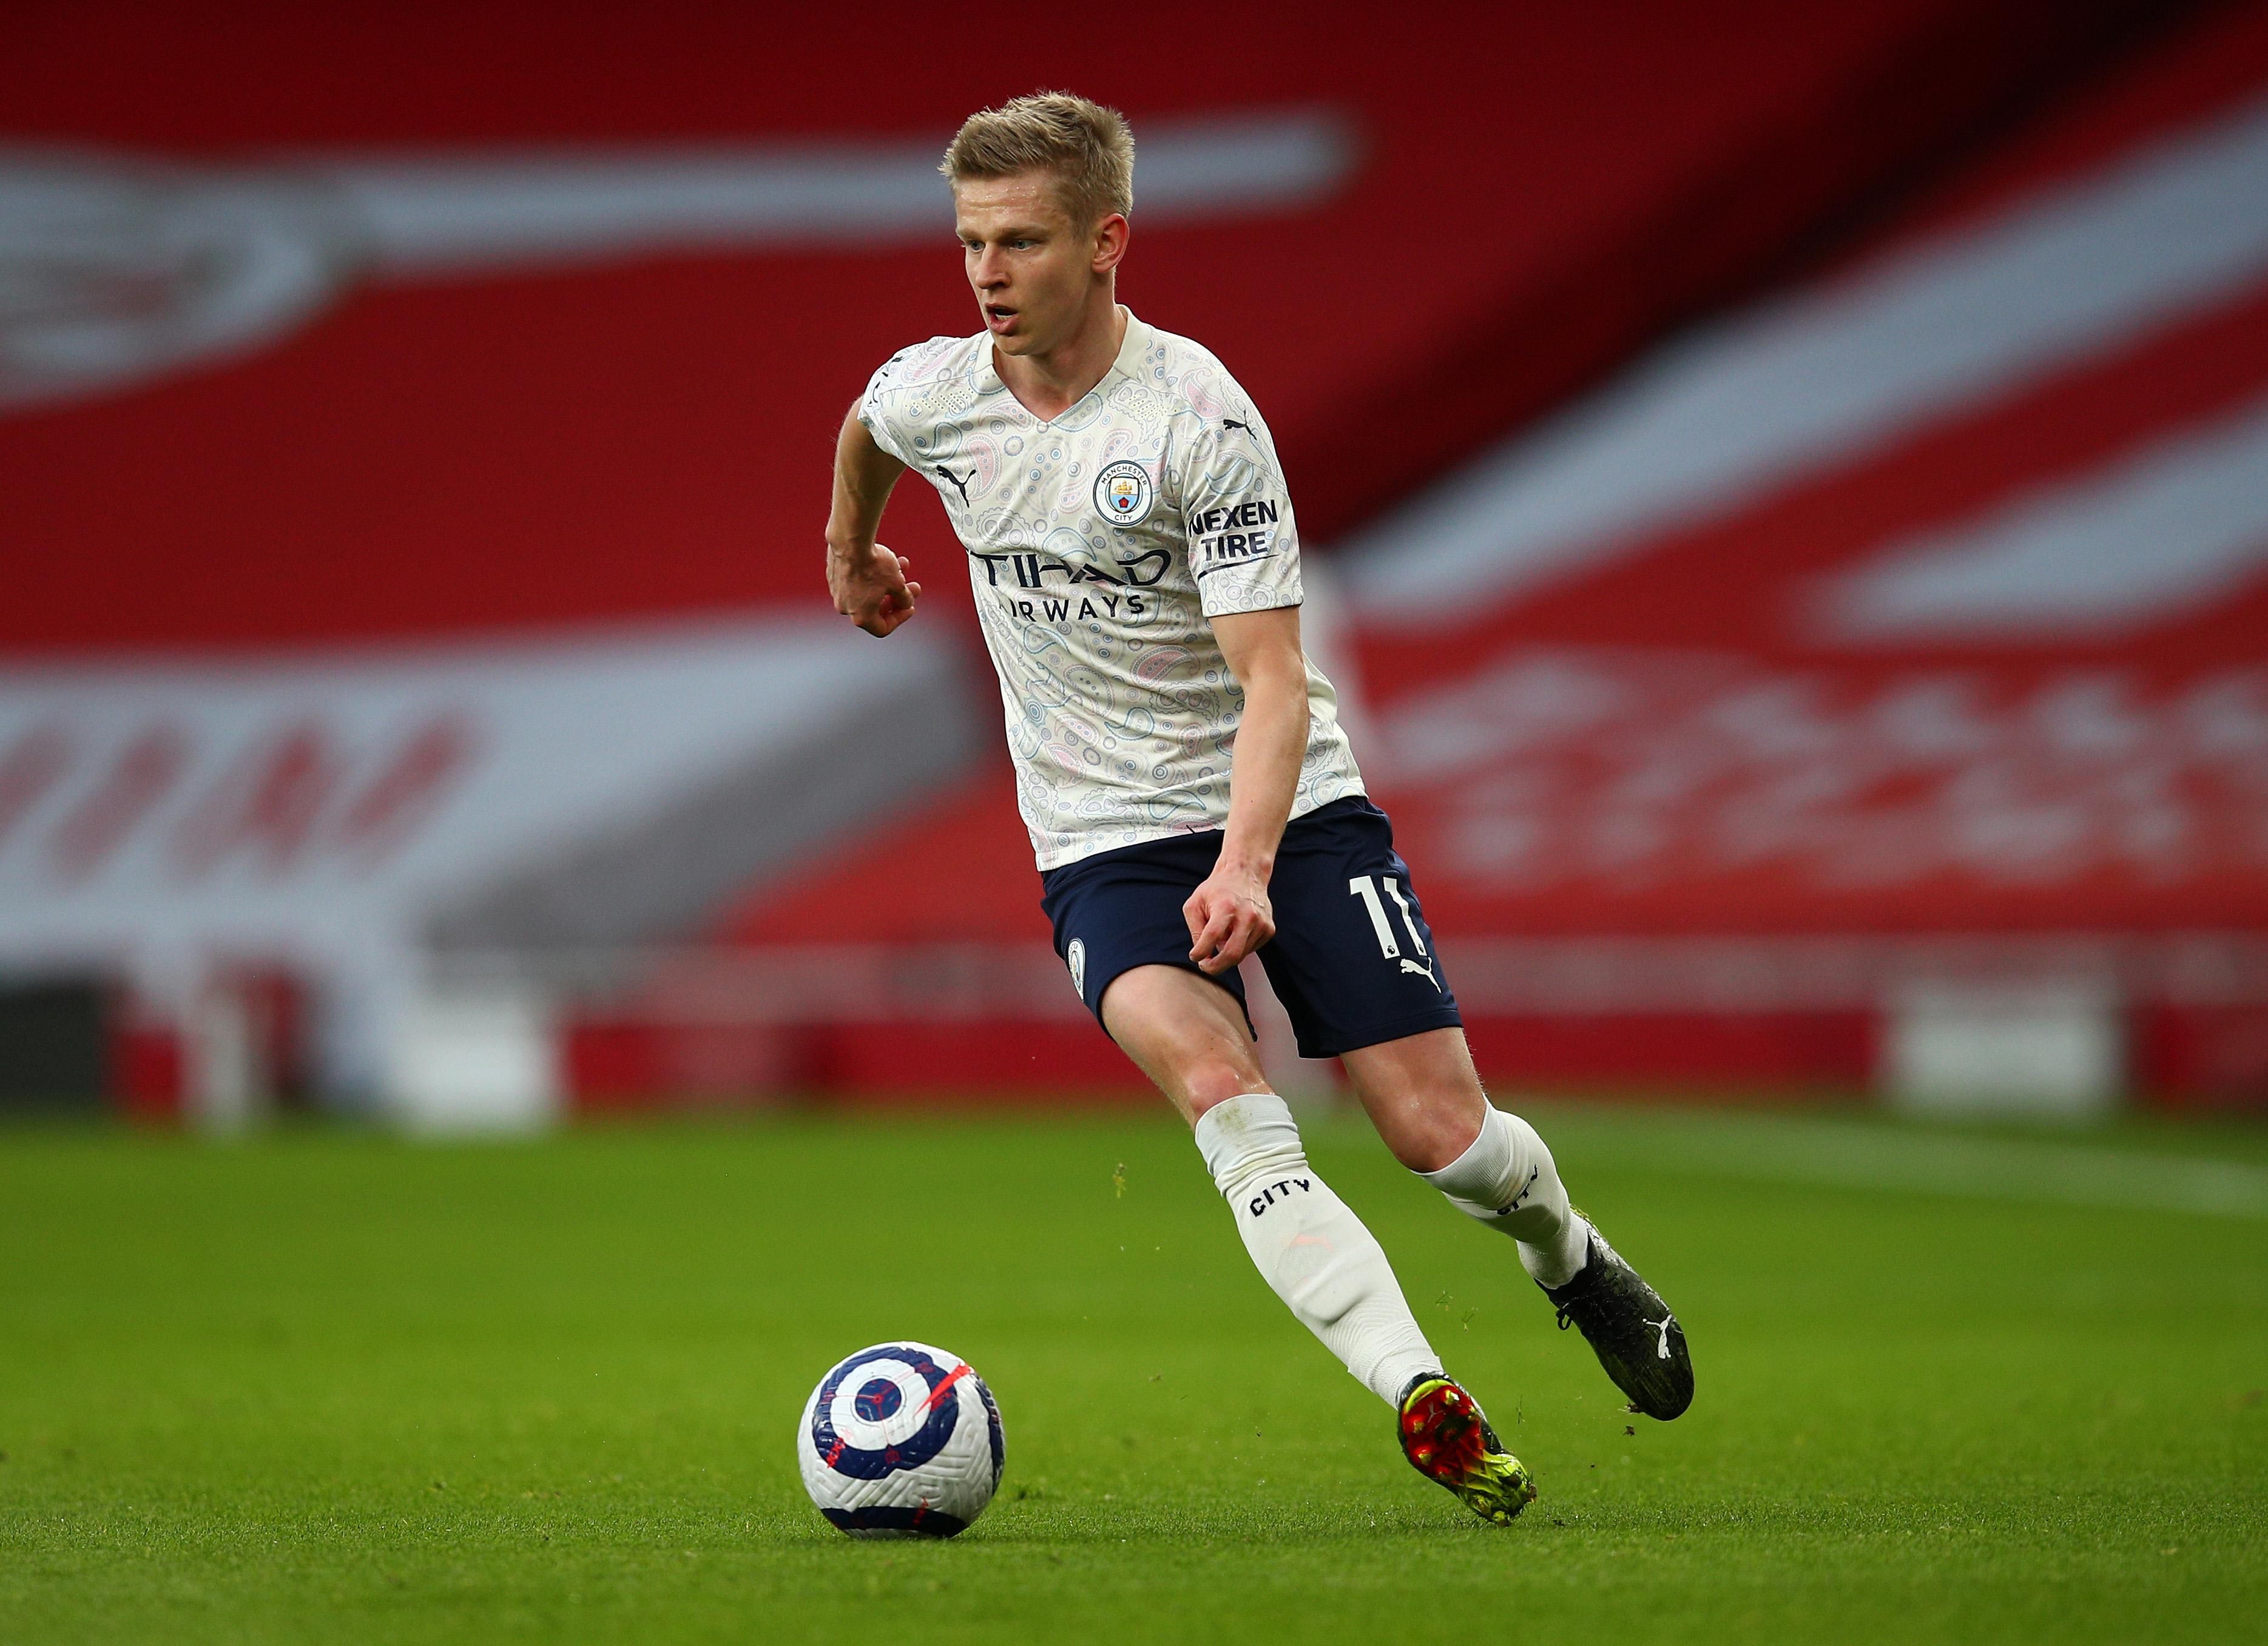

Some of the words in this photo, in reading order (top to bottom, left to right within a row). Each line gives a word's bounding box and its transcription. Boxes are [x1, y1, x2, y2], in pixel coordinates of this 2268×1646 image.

[1101, 465, 1147, 486] MANCHESTER
[1188, 499, 1278, 538] NEXEN
[1201, 531, 1268, 561] TIRE
[970, 549, 1172, 588] TIHAD
[999, 595, 1145, 622] IRWAYS
[1349, 875, 1428, 959] 11
[1249, 1179, 1310, 1218] CITY
